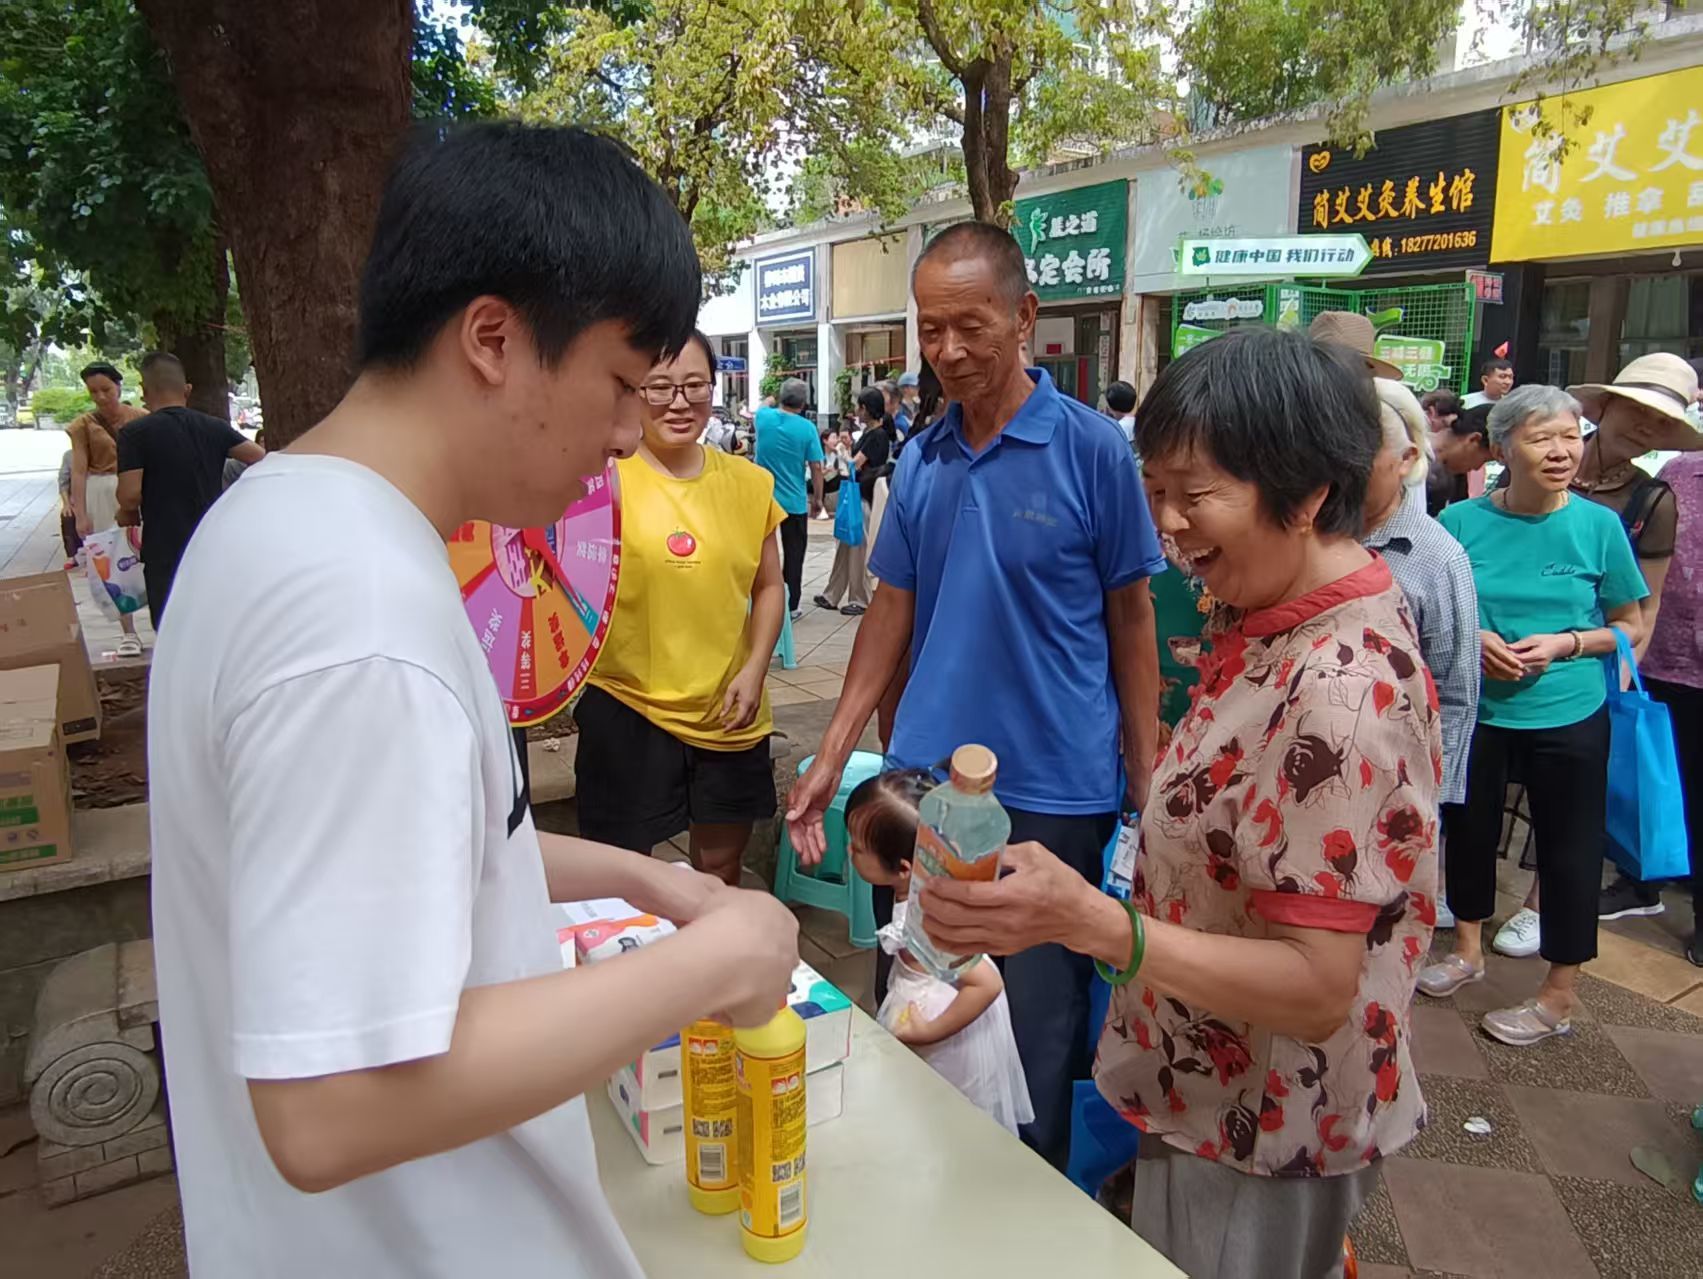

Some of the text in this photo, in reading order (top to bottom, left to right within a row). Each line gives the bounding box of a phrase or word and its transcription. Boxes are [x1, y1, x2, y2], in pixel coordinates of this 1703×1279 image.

[1312, 167, 1477, 230] 简艾艾灸养生馆
[1604, 186, 1664, 219] 推拿
[1215, 247, 1355, 264] 健康中国 我们行动
